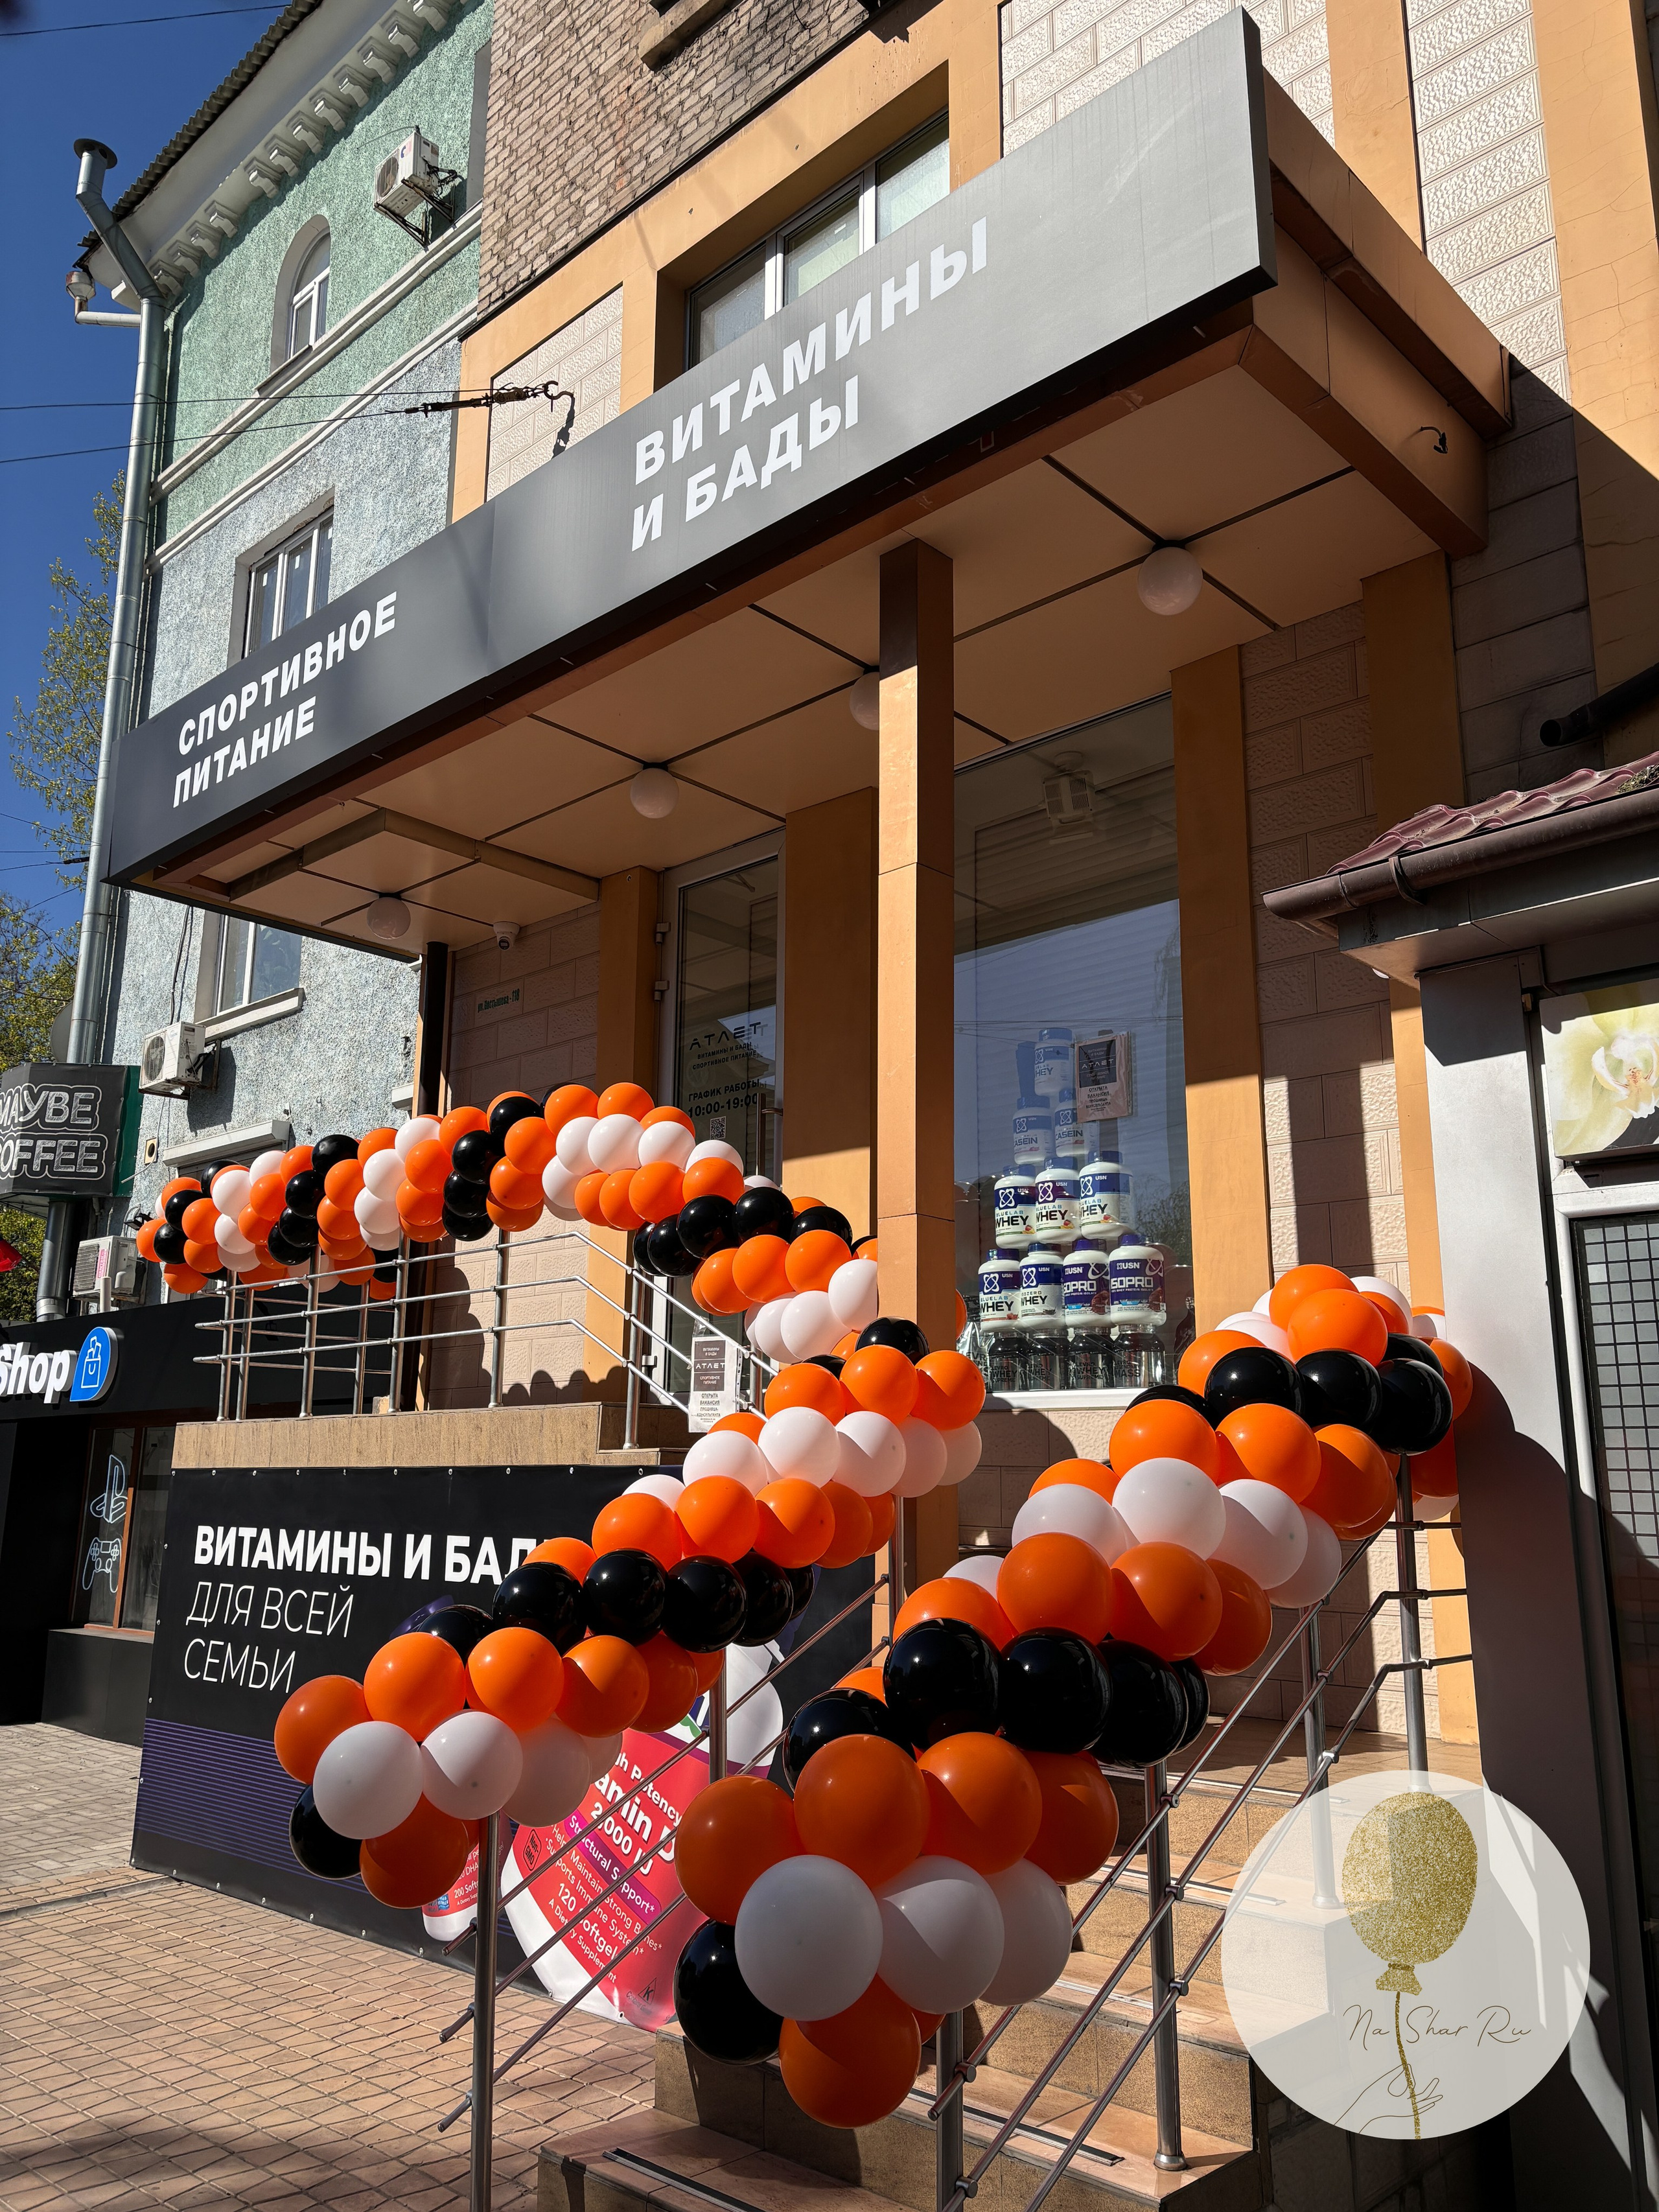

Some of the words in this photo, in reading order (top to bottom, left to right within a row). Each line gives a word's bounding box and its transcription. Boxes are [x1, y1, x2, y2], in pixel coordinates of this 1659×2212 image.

[636, 216, 987, 485] ВИТАМИНЫ
[631, 493, 664, 552] И
[686, 374, 858, 522] БАДЫ
[179, 591, 397, 755] СПОРТИВНОЕ
[172, 695, 316, 809] ПИТАНИЕ
[690, 1021, 761, 1051] АТЛЕТ
[692, 1056, 729, 1070] СПОРТИВНОЕ
[730, 1050, 756, 1061] ПИТАНИЕ
[697, 1048, 728, 1060] ВИТАМИНЫ
[735, 1042, 752, 1051] БАДЫ
[1082, 1058, 1114, 1069] АТЛЕТ
[689, 1087, 721, 1102] ГРАФИК
[725, 1078, 760, 1094] РАБОТЫ
[688, 1093, 758, 1118] 10:00-19:00
[1, 1139, 100, 1173] OFFEE
[194, 1525, 392, 1578] ВИТАМИНЫ
[404, 1533, 432, 1580] И
[445, 1535, 552, 1585] БАД
[185, 1581, 255, 1627] ДЛЯ
[261, 1585, 354, 1638] ВСЕЙ
[183, 1638, 296, 1694] СЕМЬИ
[465, 1861, 479, 1876] DHA
[525, 1845, 535, 1866] GMO
[454, 1887, 465, 1899] 200
[548, 1898, 555, 1909] A
[558, 1883, 576, 1912] 120
[570, 1850, 603, 1894] Maintain
[634, 1922, 662, 1951] Bnes
